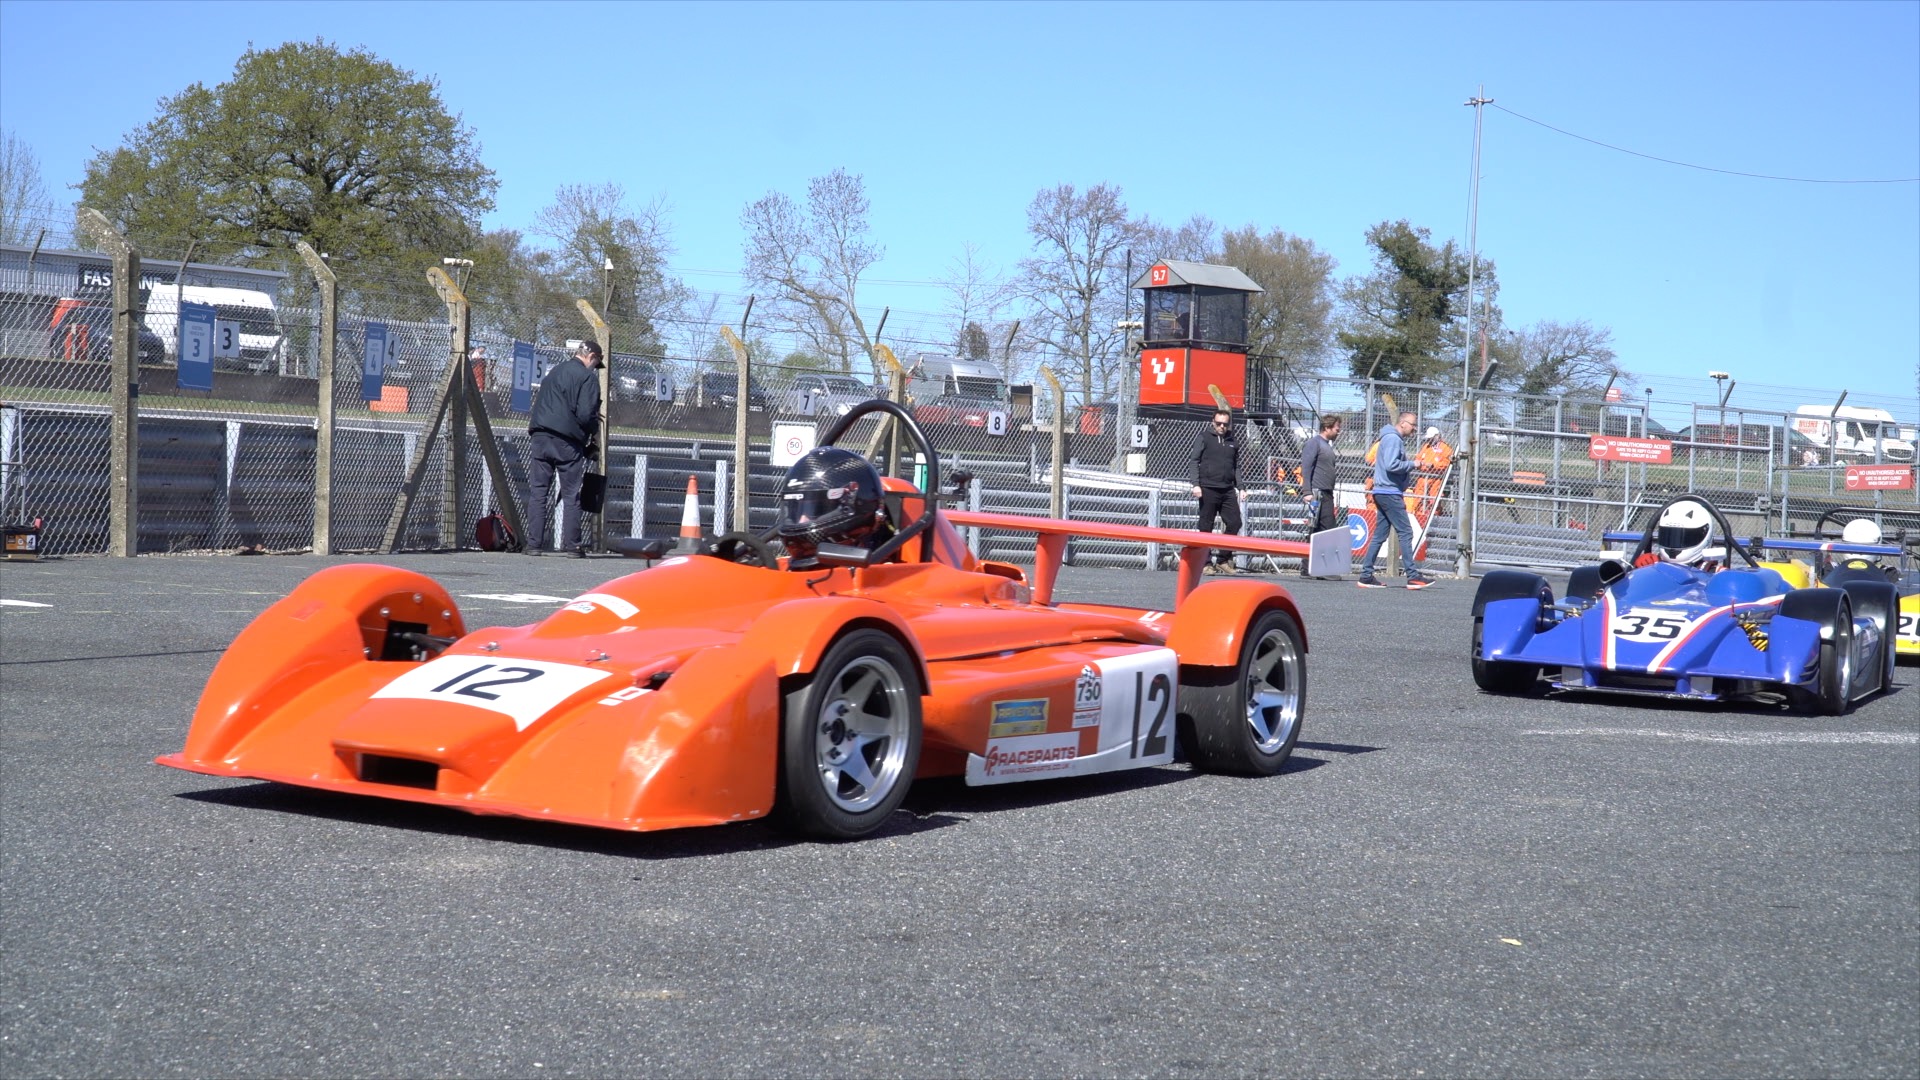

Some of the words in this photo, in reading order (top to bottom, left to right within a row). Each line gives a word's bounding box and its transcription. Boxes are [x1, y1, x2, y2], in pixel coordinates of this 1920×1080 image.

[1154, 270, 1166, 281] 9.7
[192, 338, 201, 357] 3
[222, 328, 232, 350] 3
[388, 340, 395, 360] 4
[371, 353, 376, 371] 4
[536, 360, 542, 379] 5
[520, 371, 525, 386] 5
[660, 378, 667, 395] 6
[803, 395, 810, 411] 7
[994, 416, 1001, 431] 8
[790, 441, 800, 449] 50
[1136, 429, 1143, 443] 9
[1613, 616, 1686, 639] 35
[430, 664, 545, 701] 12
[1077, 682, 1101, 702] 750
[1130, 671, 1170, 760] 12
[999, 746, 1075, 766] RACEPARTS
